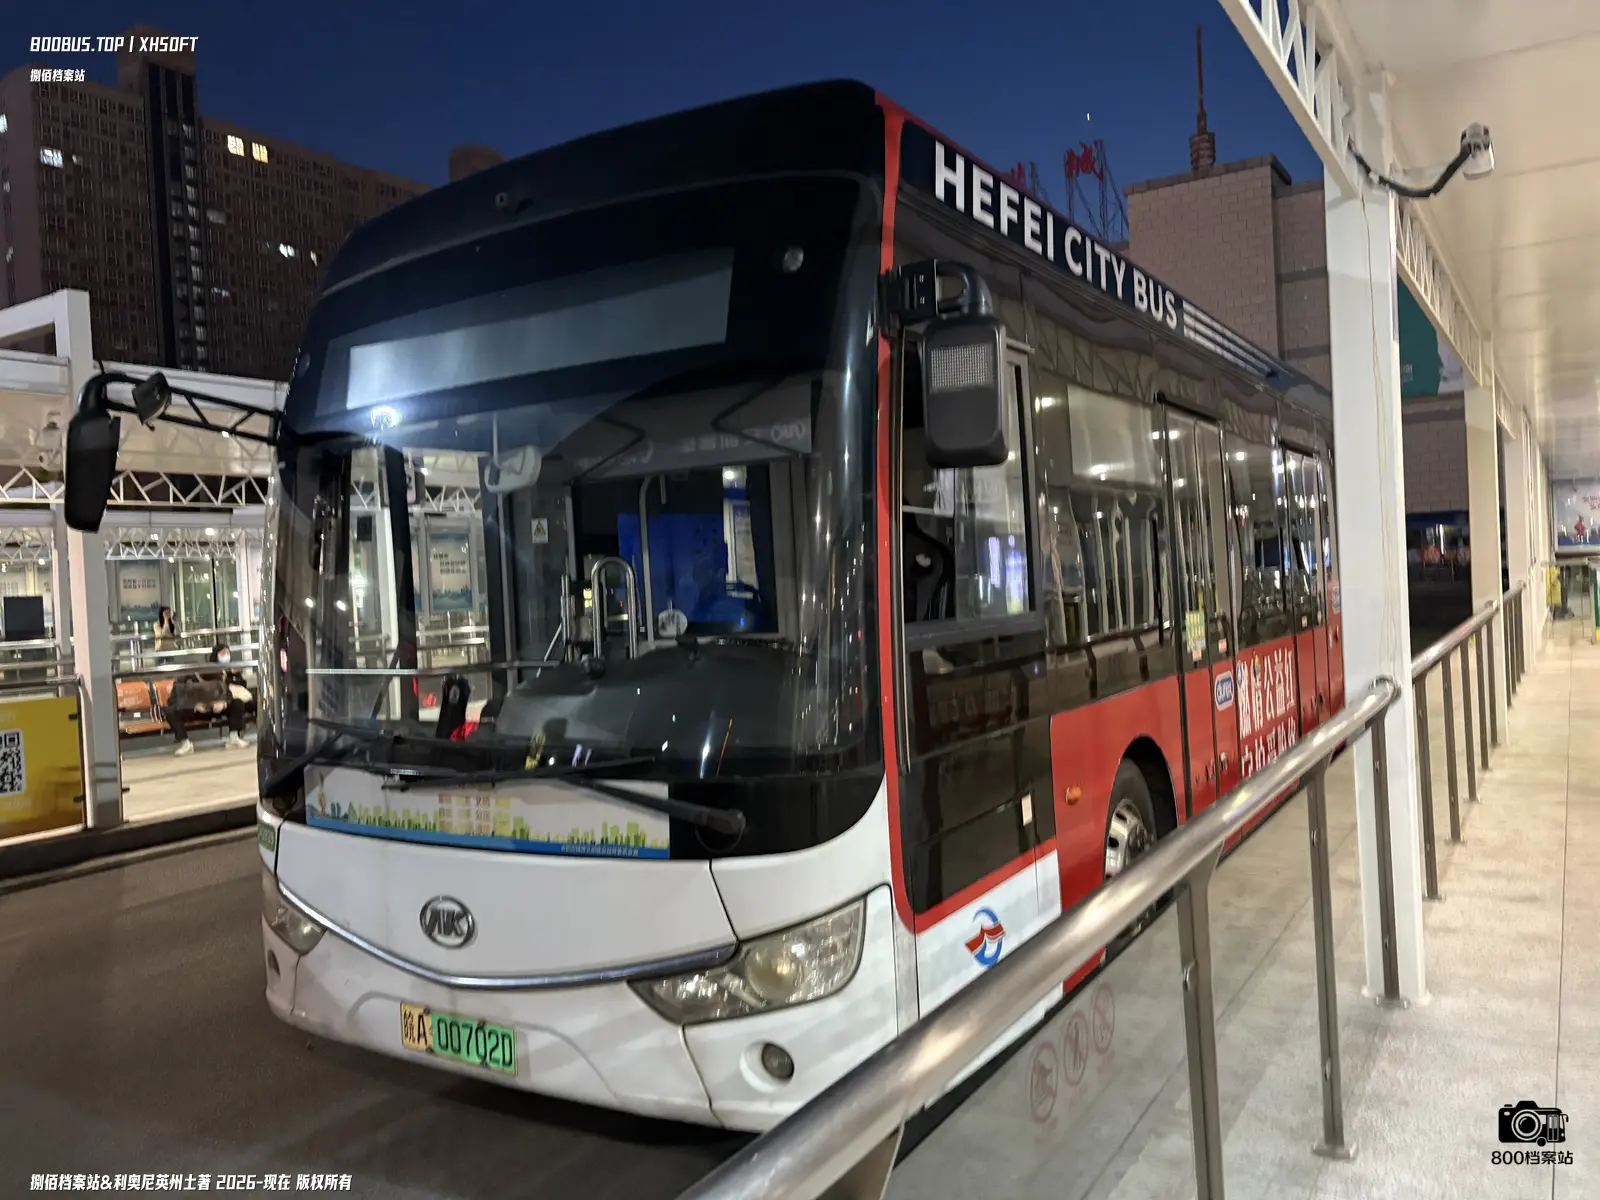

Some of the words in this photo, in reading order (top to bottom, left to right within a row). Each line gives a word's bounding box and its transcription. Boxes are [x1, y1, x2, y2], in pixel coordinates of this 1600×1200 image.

[935, 140, 1055, 262] HEFEI
[1064, 226, 1126, 301] CITY
[1133, 267, 1178, 330] BUS
